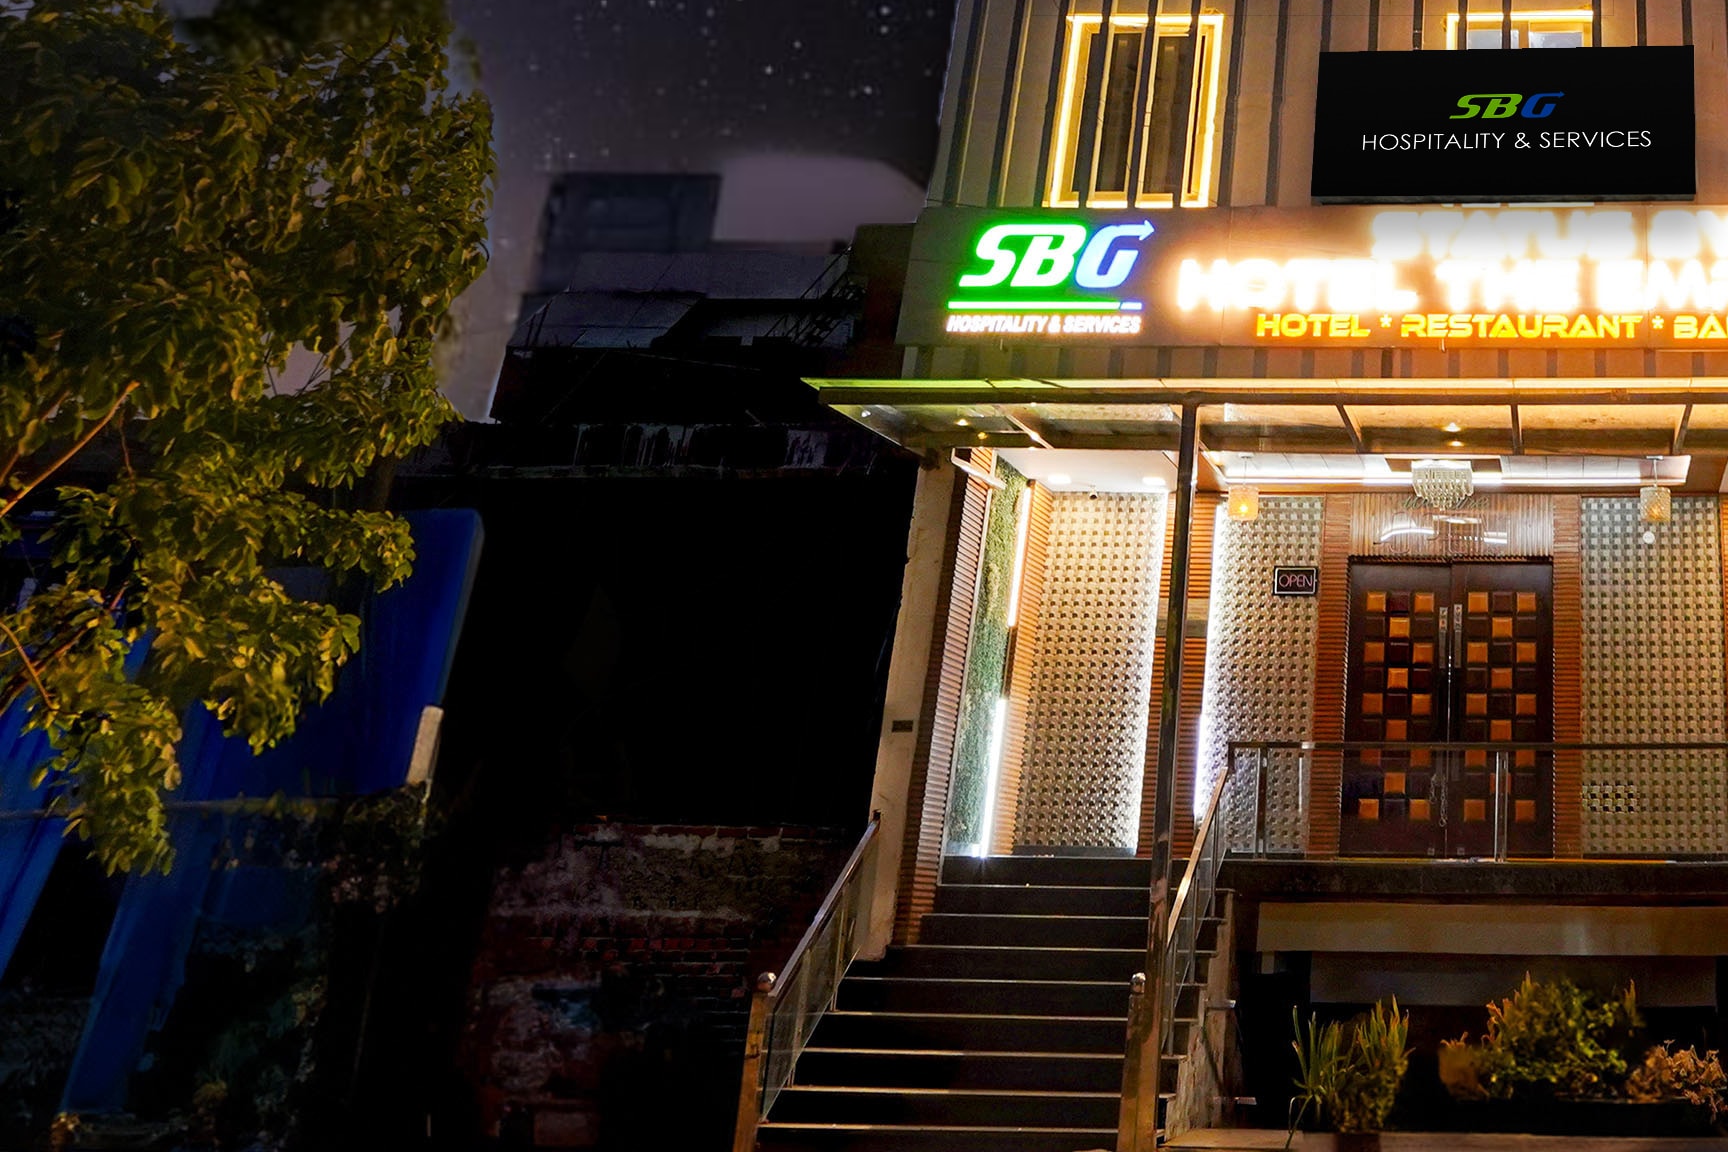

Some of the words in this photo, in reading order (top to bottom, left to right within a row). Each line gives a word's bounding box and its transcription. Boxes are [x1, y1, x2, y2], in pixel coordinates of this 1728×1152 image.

[1449, 91, 1565, 119] SBG
[1361, 132, 1506, 151] HOSPITALITY
[1514, 132, 1532, 149] &
[1539, 130, 1652, 149] SERVICES
[958, 219, 1154, 289] SBG
[1178, 256, 1417, 312] HOTEL
[1436, 256, 1581, 312] THE
[946, 314, 1048, 334] HOSPITALITY
[1048, 315, 1061, 334] &
[1063, 315, 1142, 335] SERVICES
[1256, 313, 1371, 338] HOTEL
[1400, 314, 1643, 338] RESTAURANT
[1279, 574, 1313, 588] OPEN
